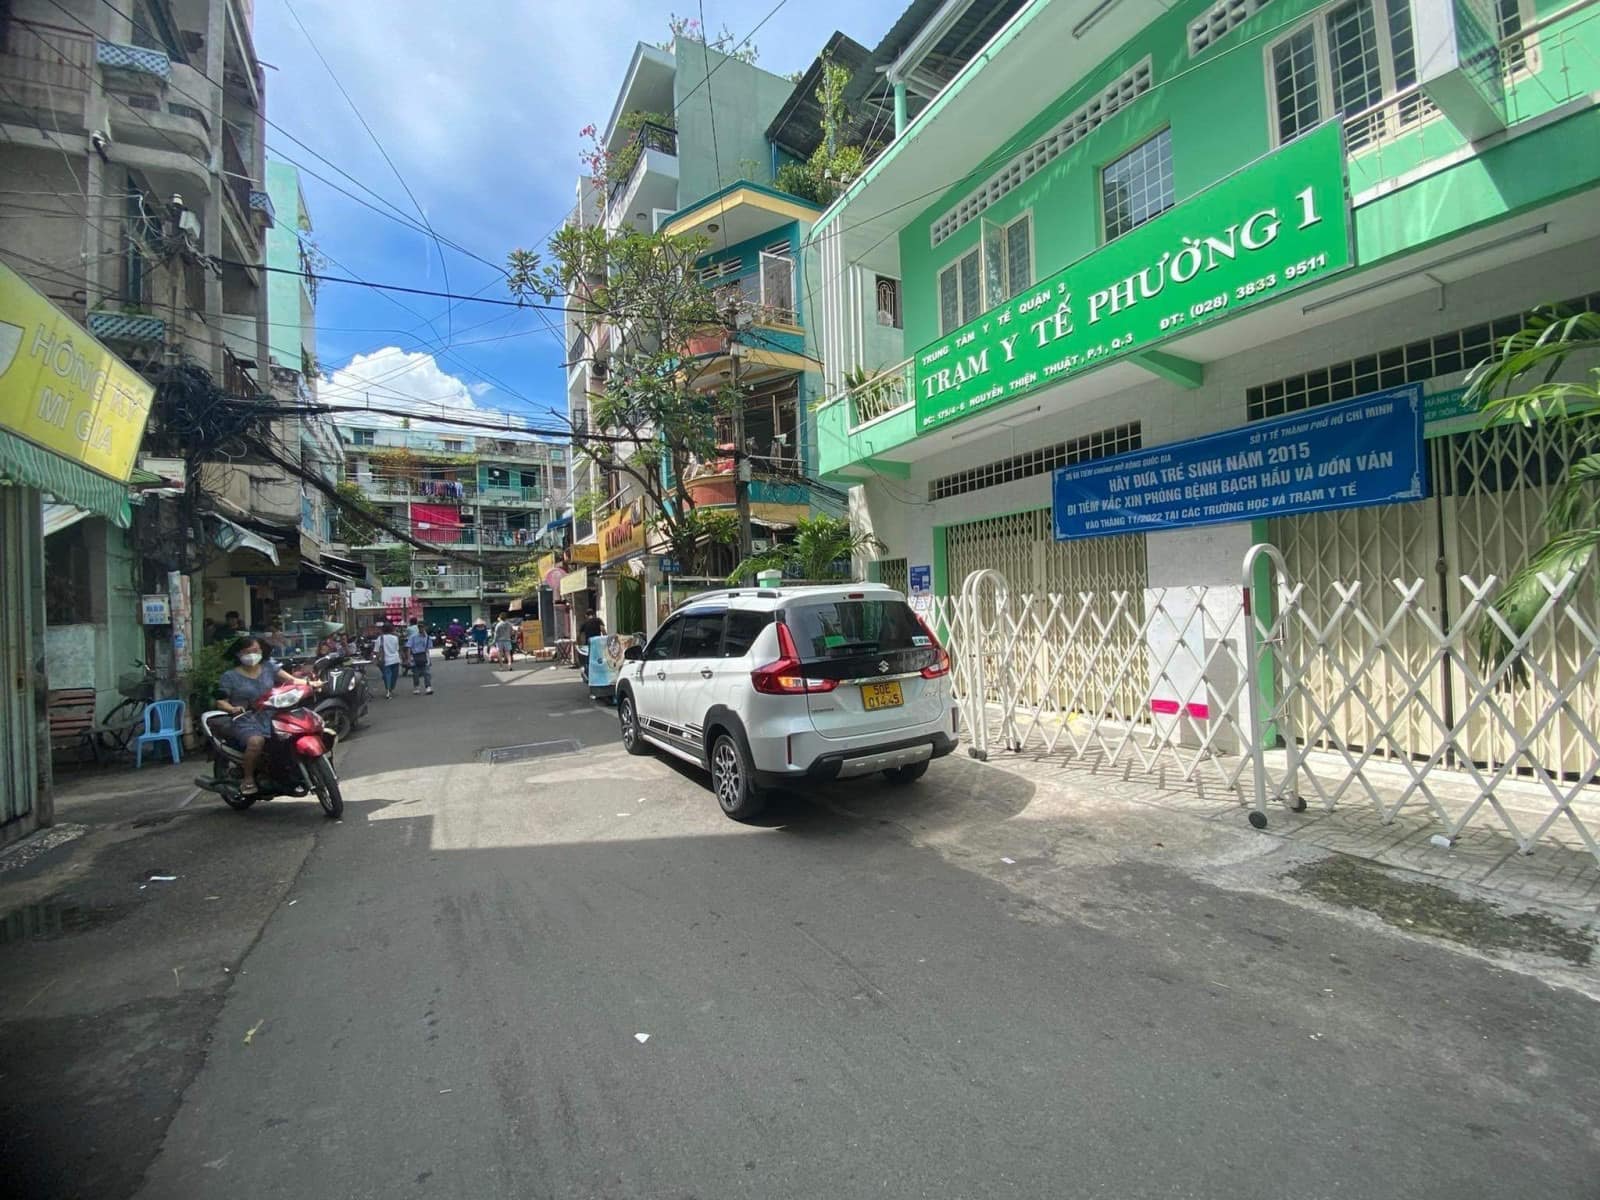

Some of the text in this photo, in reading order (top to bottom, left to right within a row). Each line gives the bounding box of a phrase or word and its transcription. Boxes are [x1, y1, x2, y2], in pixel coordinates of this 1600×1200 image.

[922, 185, 1322, 399] TRẠM Y TẾ PHƯỜNG 1
[922, 282, 1066, 367] TRUNG TÂM Y TẾ QUẬN 3
[969, 383, 1004, 407] NGUYỄN
[1008, 371, 1037, 391] THIỆN
[1159, 312, 1185, 330] ĐT:
[1190, 292, 1228, 318] (028)
[1235, 273, 1277, 299] 3833
[1284, 253, 1326, 280] 9511
[75, 409, 113, 455] GIA
[1262, 432, 1268, 441] Y
[1365, 403, 1393, 418] MINH
[1067, 503, 1076, 516] ĐI
[1125, 494, 1142, 508] XIN
[1144, 488, 1181, 505] PHÒNG
[1185, 482, 1217, 500] BỆNH
[1221, 475, 1257, 494] BẠCH
[1261, 466, 1291, 488] HẦU
[1295, 462, 1313, 482] VÀ
[1109, 442, 1310, 492] HÃY ĐƯA TRẺ SINH NĂM 2015
[1085, 519, 1099, 530] VÀO
[1101, 516, 1125, 528] THÁNG
[1165, 511, 1179, 521] TẠI
[1181, 506, 1201, 518] CÁC
[1203, 501, 1244, 516] TRƯỜNG
[1247, 498, 1269, 511] HỌC
[1272, 494, 1286, 506] VÀ
[1289, 487, 1324, 503] TRẠM
[1328, 487, 1338, 498] Y
[1340, 481, 1358, 497] TẾ
[873, 683, 891, 695] 50E
